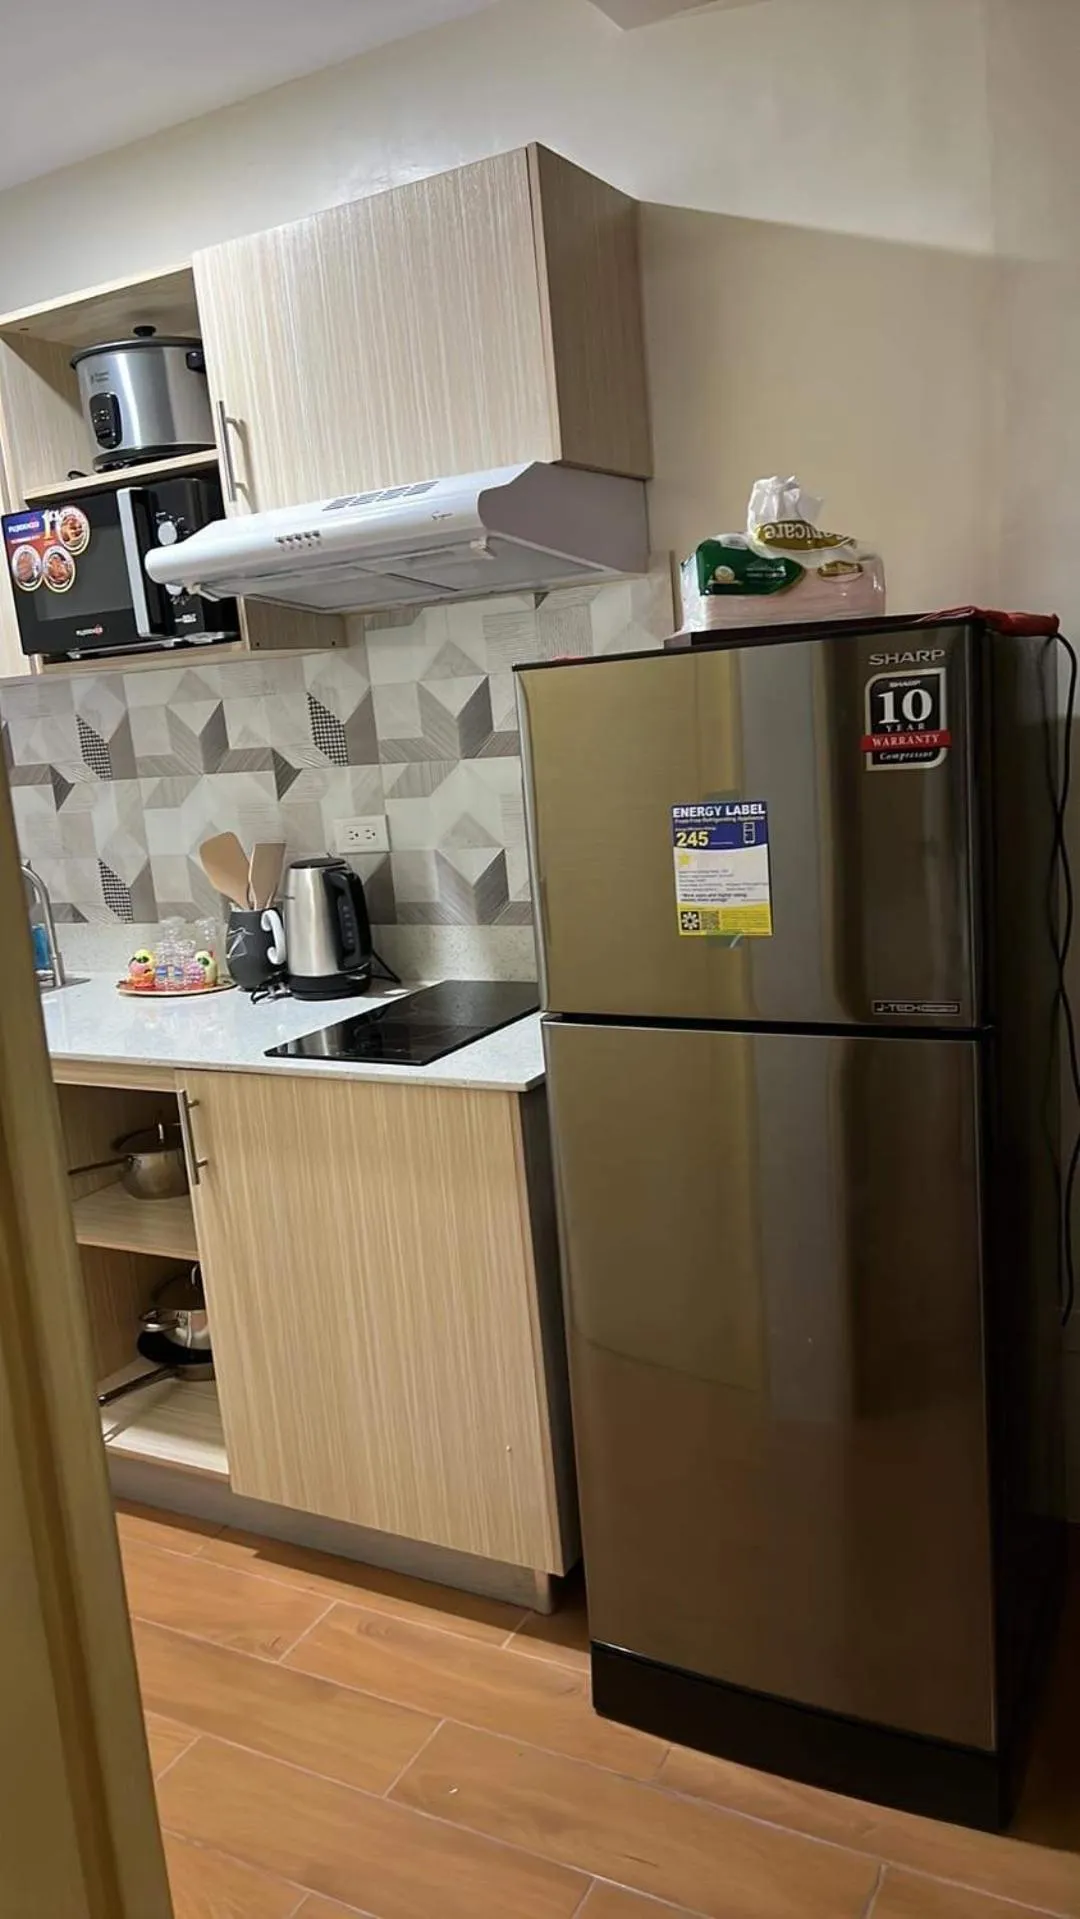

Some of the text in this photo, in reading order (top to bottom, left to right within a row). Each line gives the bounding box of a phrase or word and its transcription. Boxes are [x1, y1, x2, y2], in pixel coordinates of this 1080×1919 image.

[868, 649, 945, 666] SHARP
[877, 689, 933, 724] 10
[886, 722, 926, 733] YEAR
[871, 734, 941, 748] WARRANTY
[879, 751, 933, 761] Compressor
[673, 804, 765, 817] ENERGY LABEL
[676, 831, 709, 846] 245
